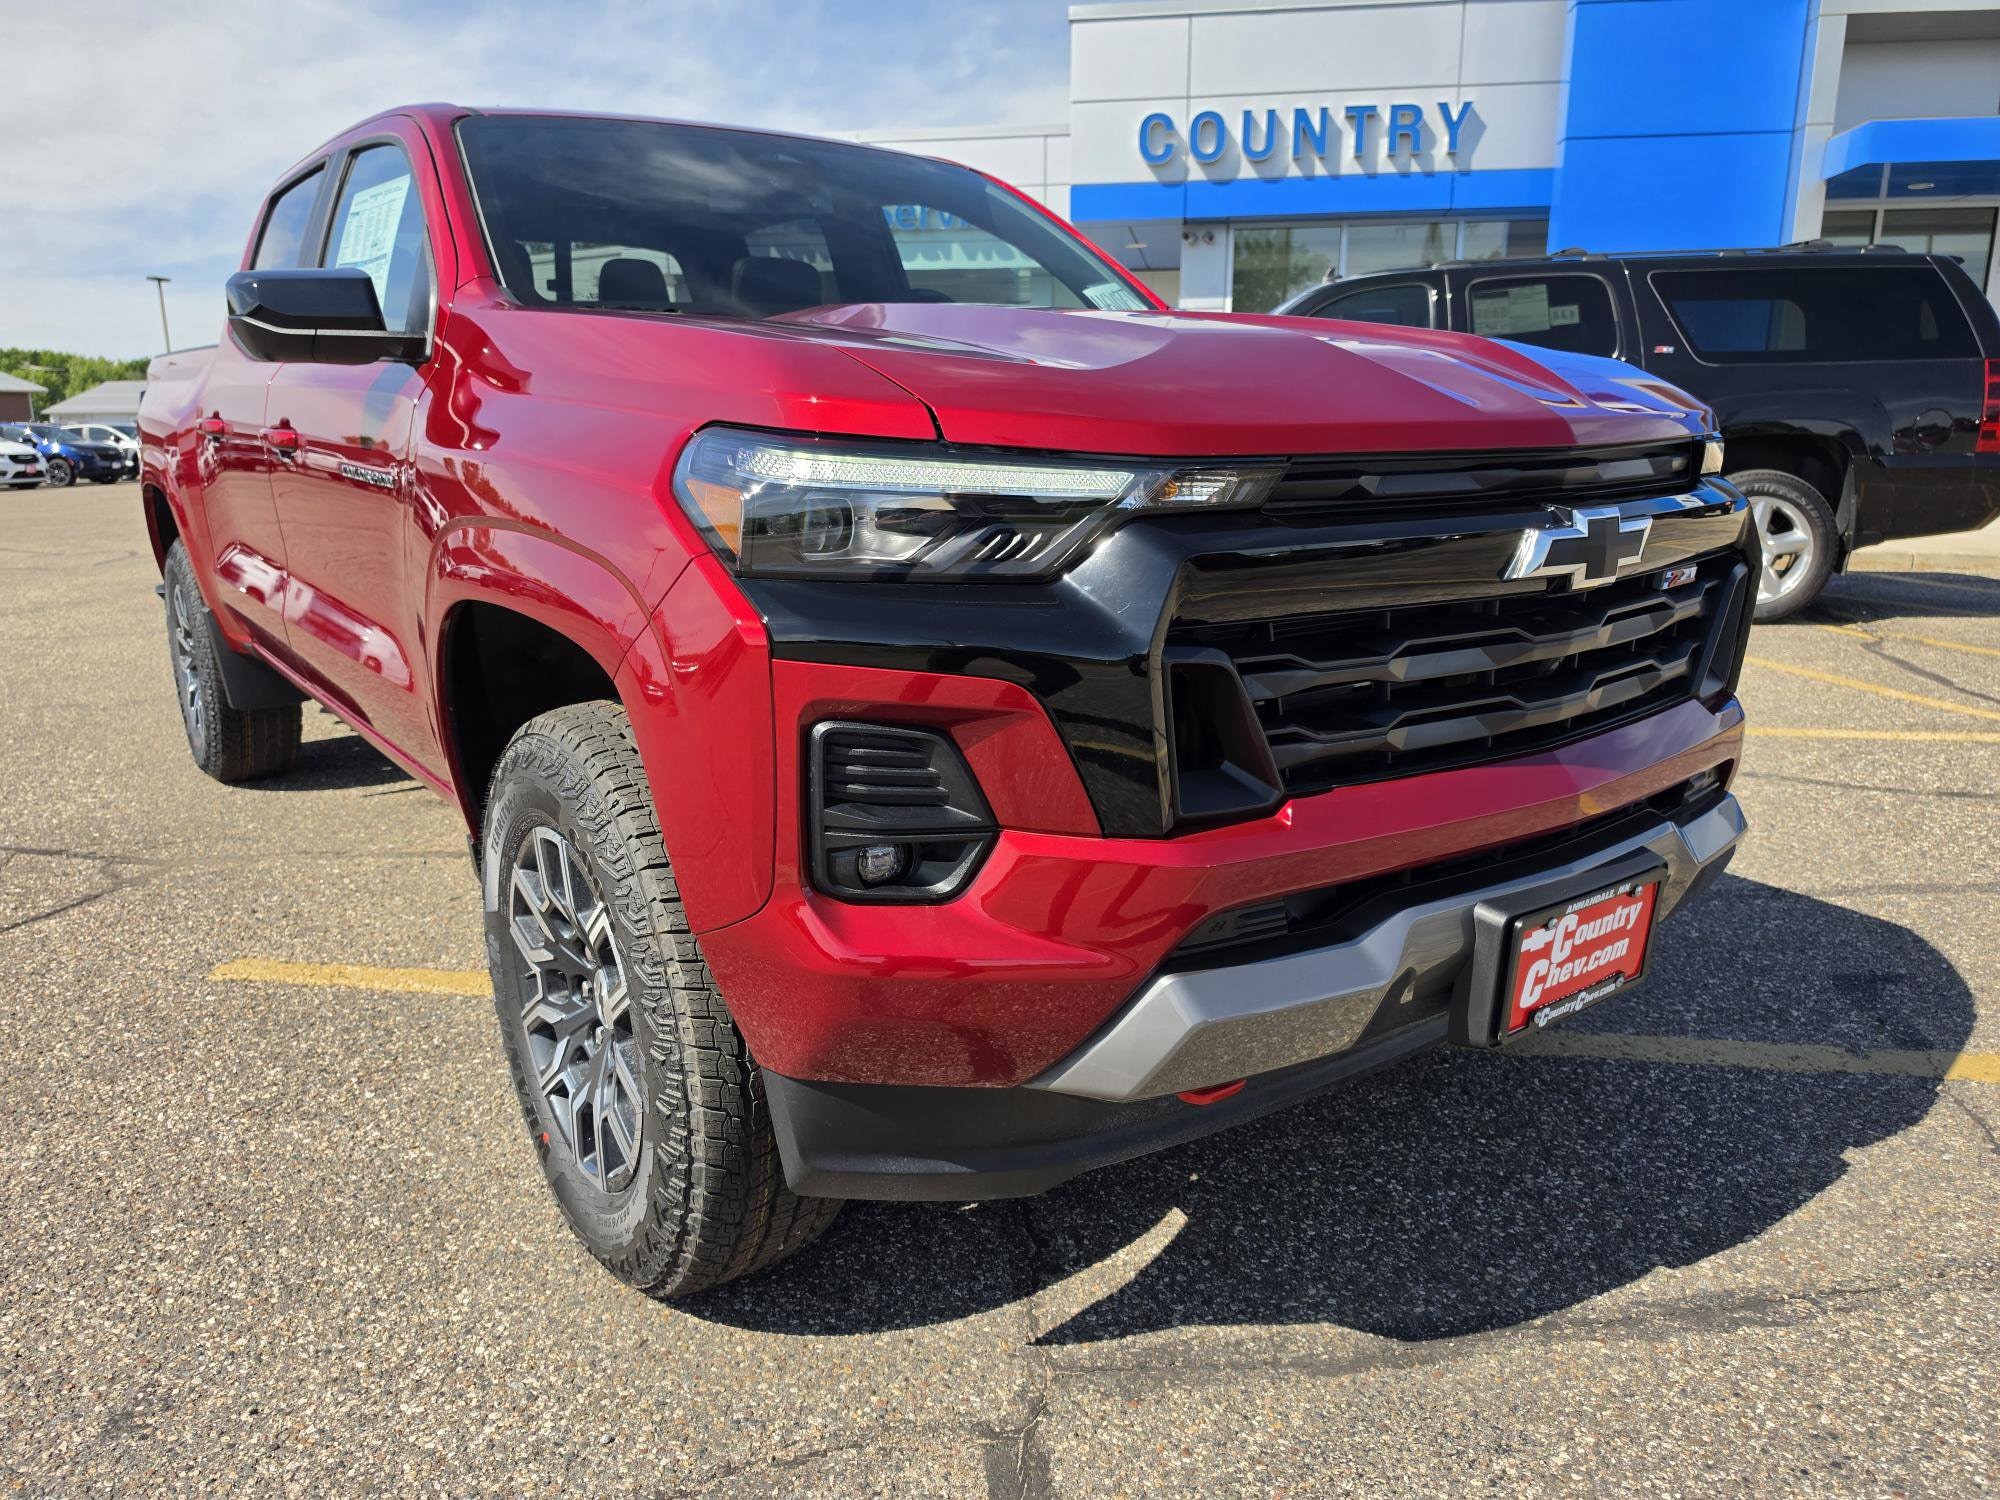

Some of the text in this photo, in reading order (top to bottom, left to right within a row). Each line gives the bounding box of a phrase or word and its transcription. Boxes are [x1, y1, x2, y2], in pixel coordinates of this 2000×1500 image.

[1139, 101, 1474, 166] COUNTRY
[1551, 902, 1643, 964] Country
[1519, 938, 1630, 1008] Chev.com
[1539, 983, 1616, 1027] CountryChev.com
